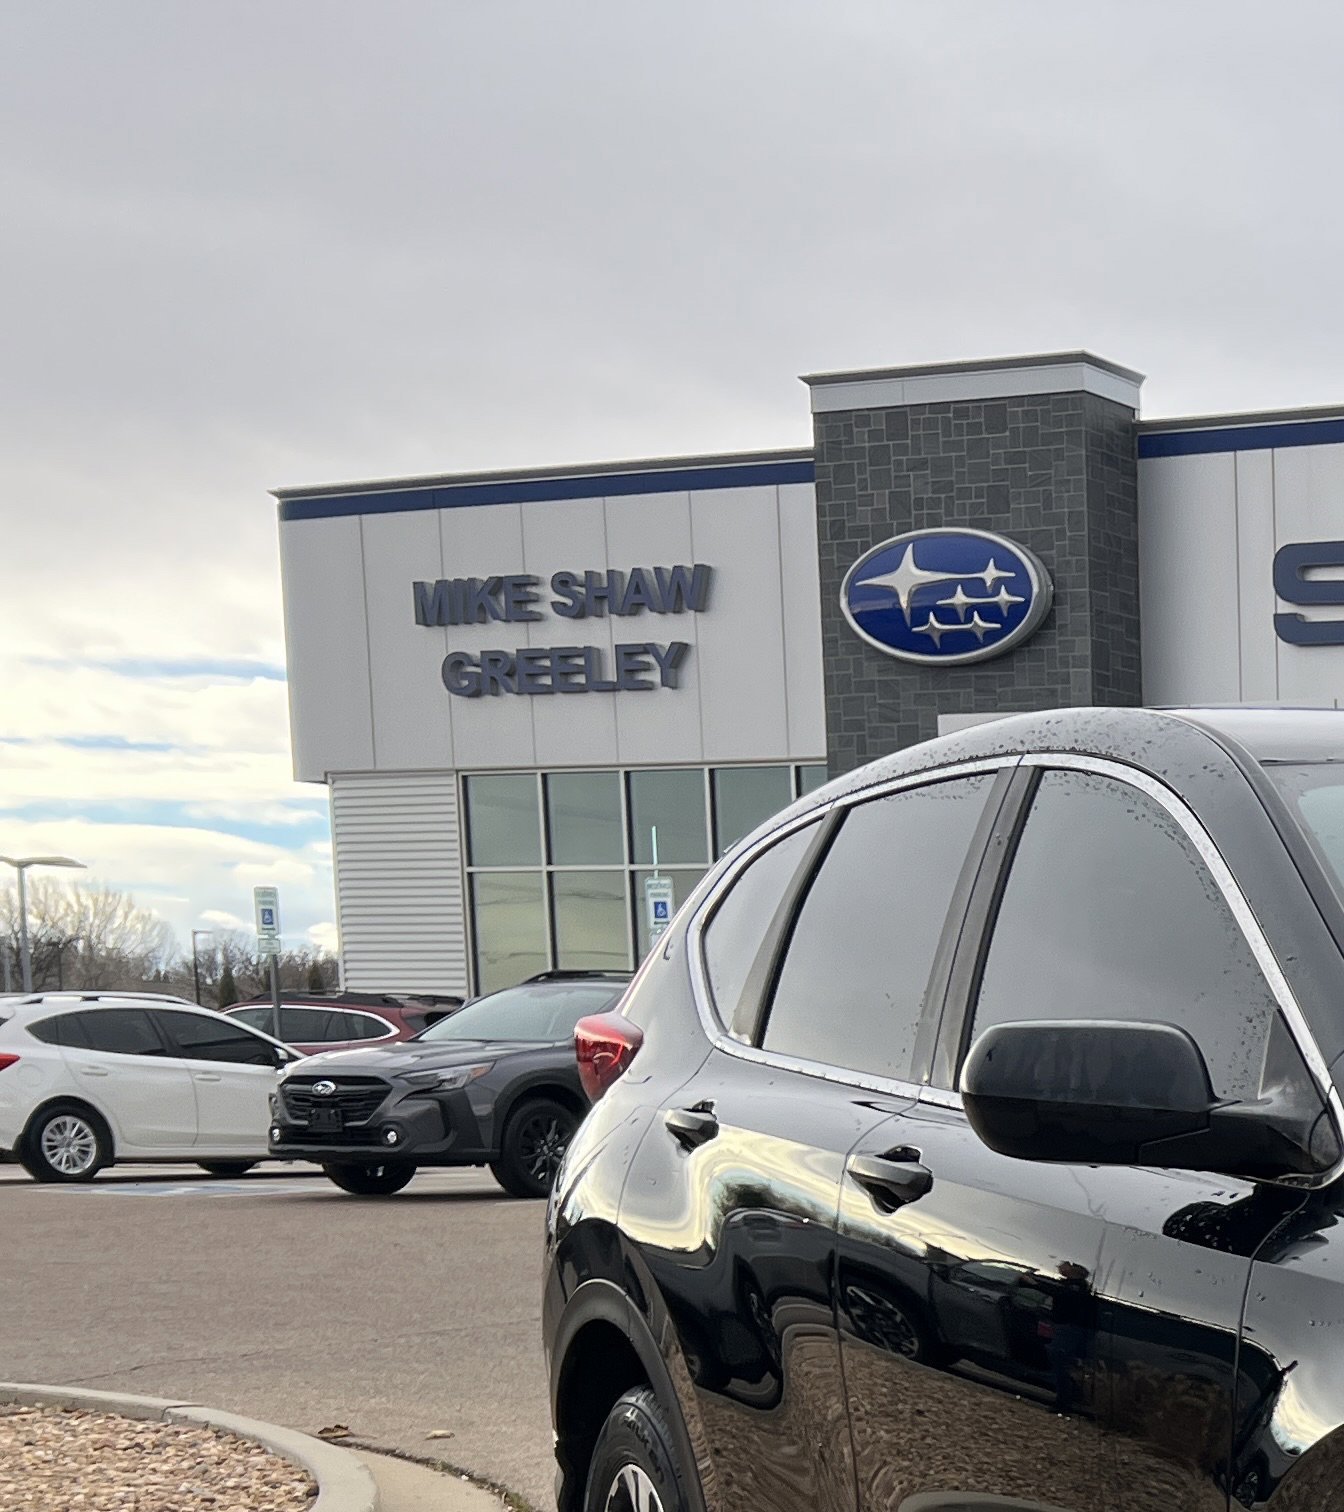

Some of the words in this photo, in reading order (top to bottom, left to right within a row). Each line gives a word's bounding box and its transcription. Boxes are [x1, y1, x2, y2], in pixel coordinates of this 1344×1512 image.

[413, 574, 545, 627] MIKE
[550, 563, 713, 619] SHAW
[441, 641, 691, 698] GREELEY
